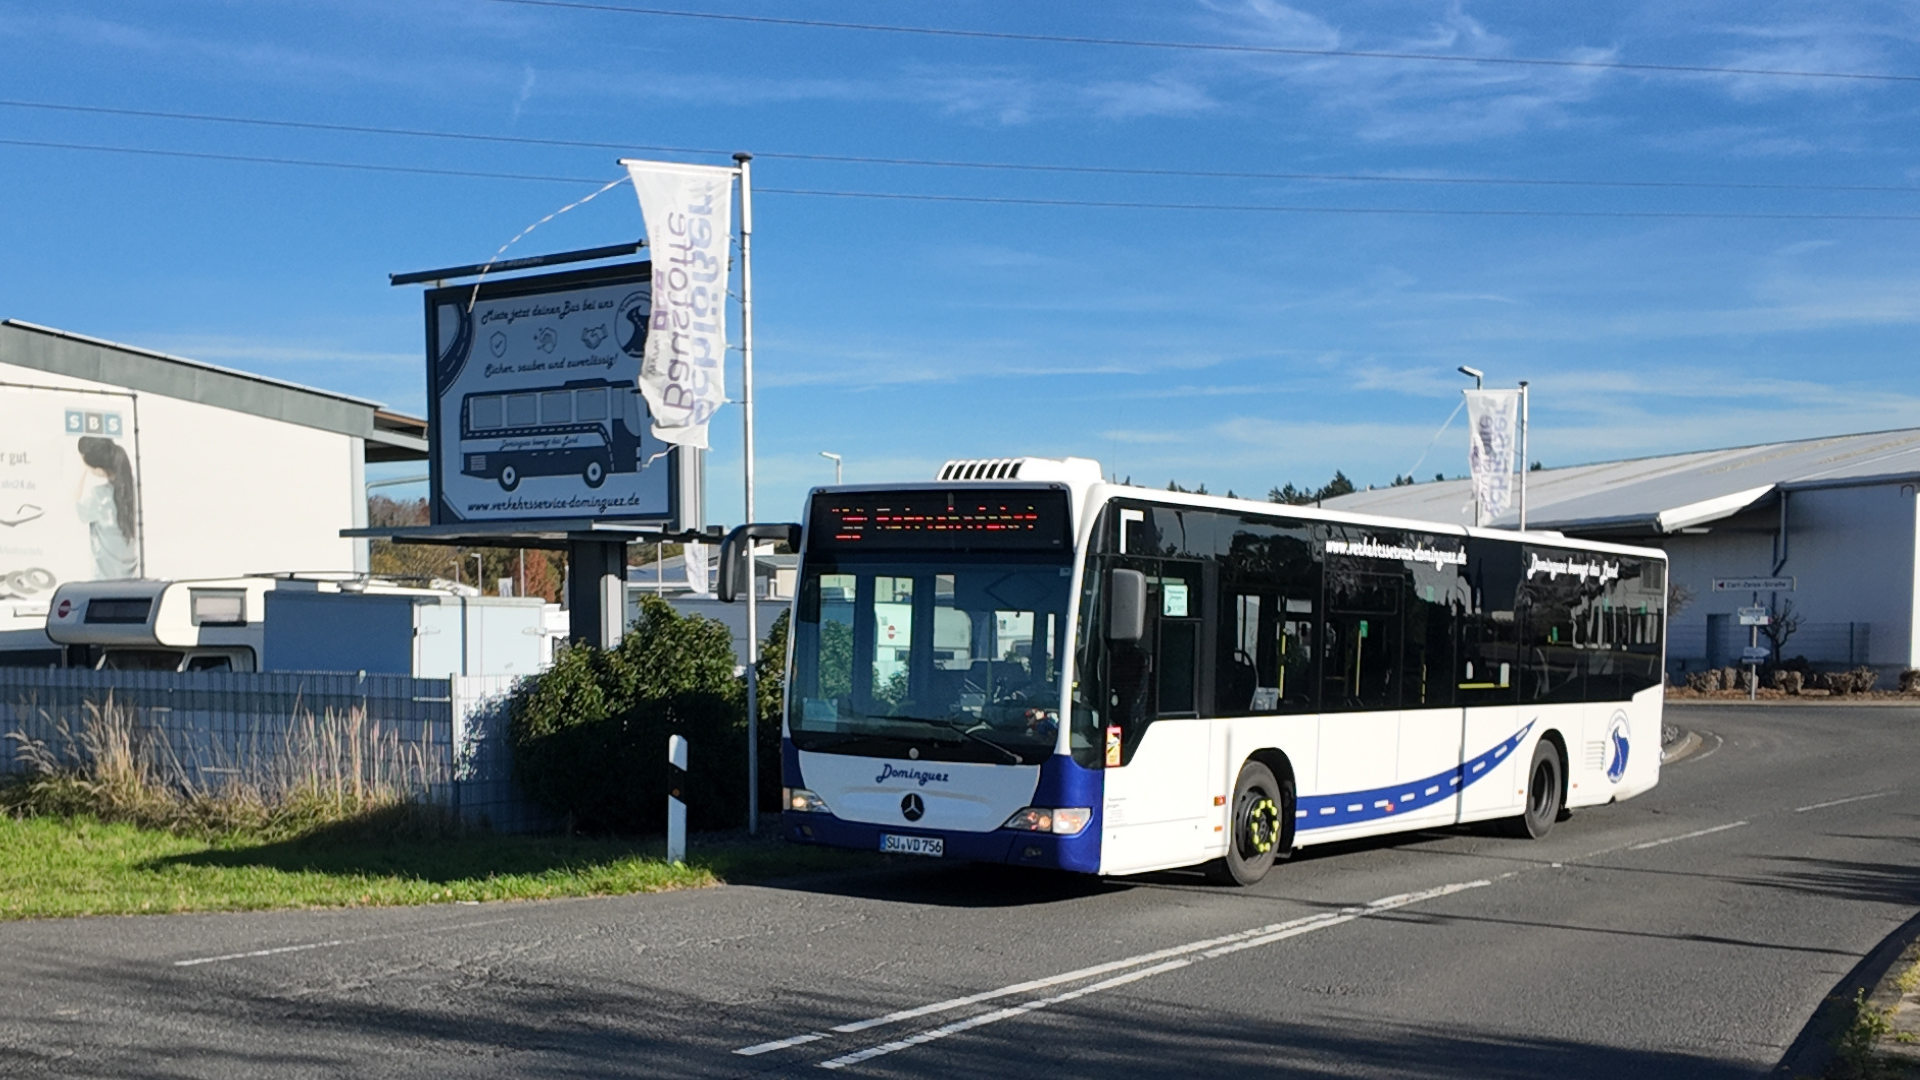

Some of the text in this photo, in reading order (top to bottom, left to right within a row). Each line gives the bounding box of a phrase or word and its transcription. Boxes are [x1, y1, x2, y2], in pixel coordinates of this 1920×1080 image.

[481, 309, 508, 325] Miete
[508, 308, 529, 325] jetzt
[559, 300, 580, 320] Bus
[582, 299, 595, 312] bei
[598, 300, 614, 309] uns
[548, 357, 566, 370] und
[67, 413, 120, 434] SBS
[9, 451, 31, 467] gut.
[467, 491, 640, 514] www.verkehrsservice-dominguez.de
[876, 763, 949, 787] Dominguez
[886, 836, 943, 854] SU VD 756
